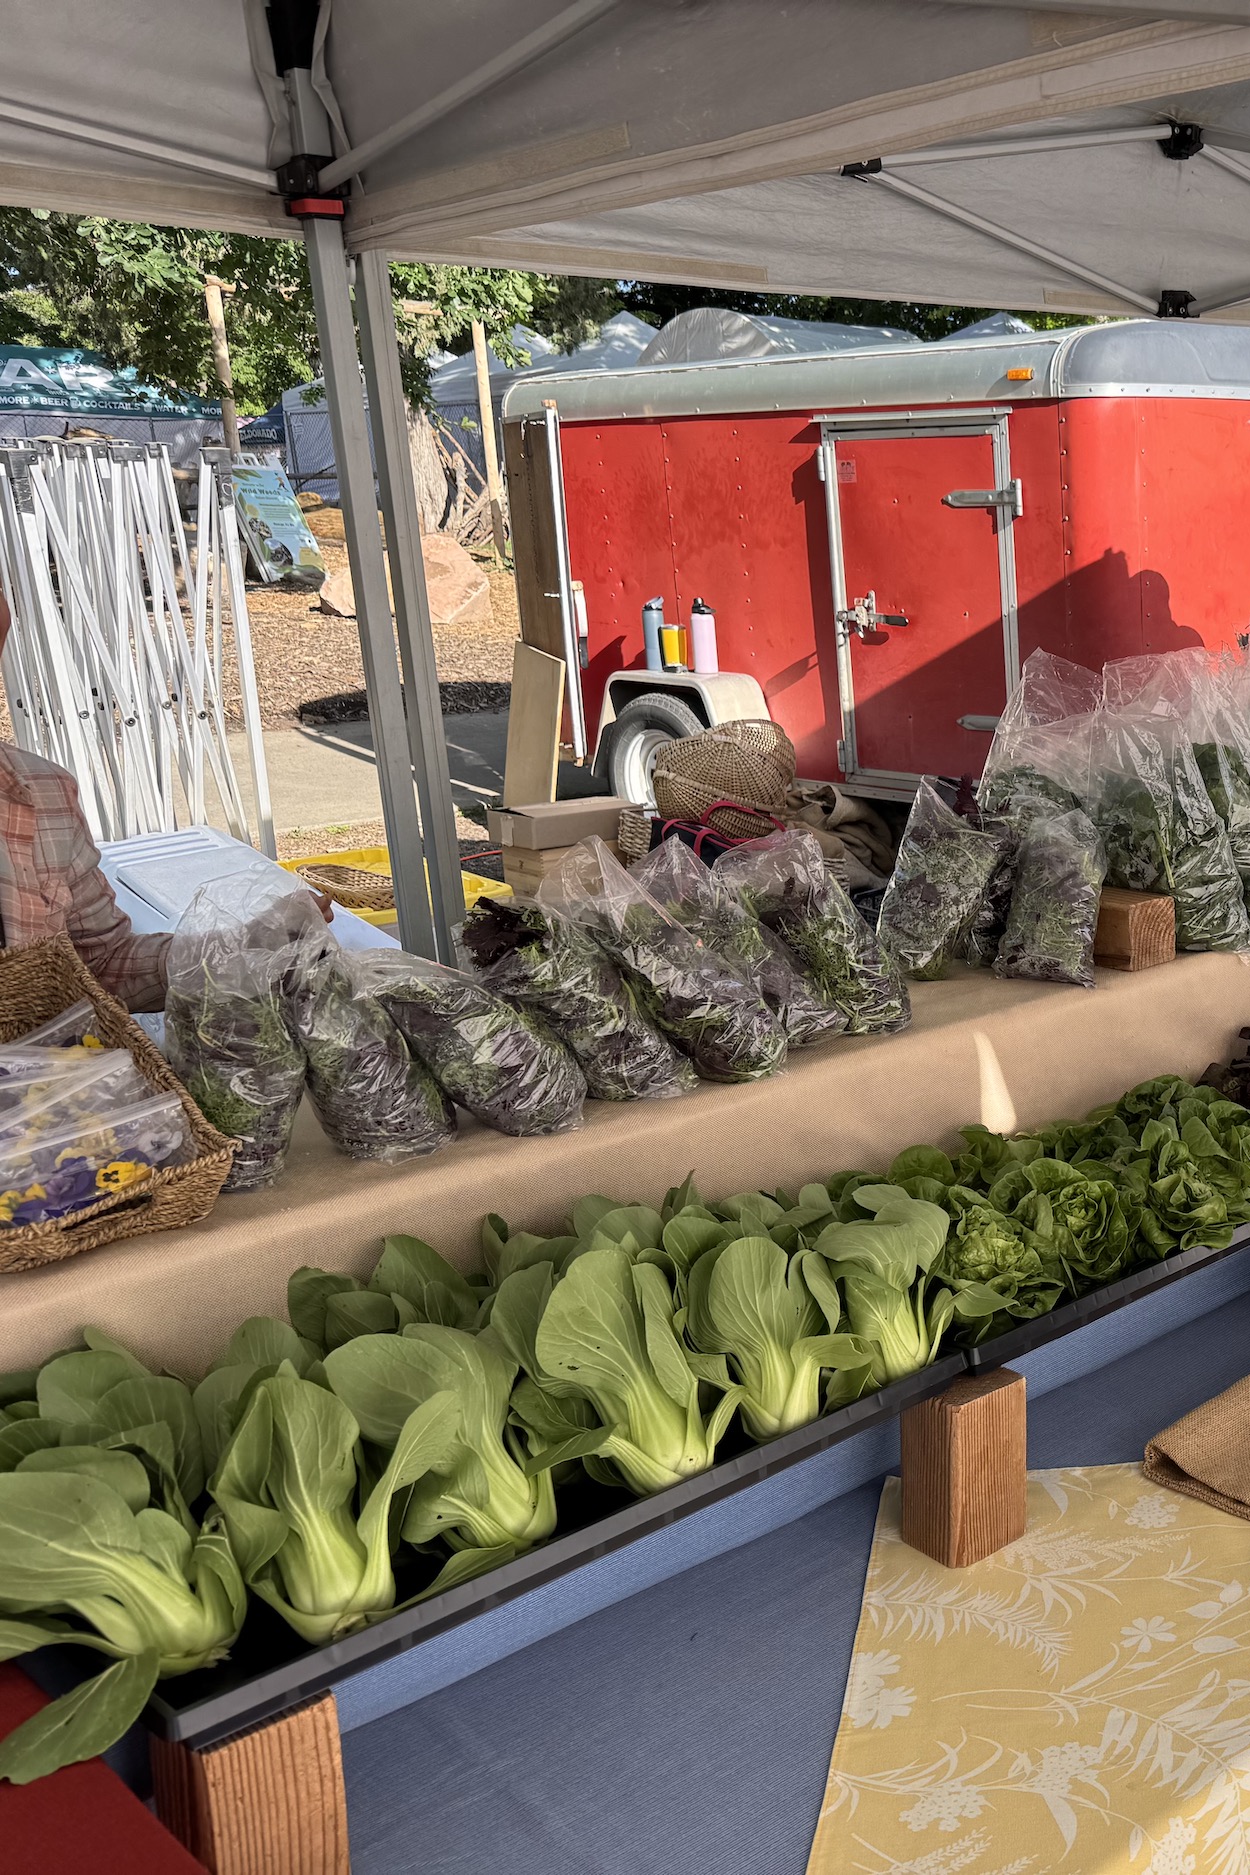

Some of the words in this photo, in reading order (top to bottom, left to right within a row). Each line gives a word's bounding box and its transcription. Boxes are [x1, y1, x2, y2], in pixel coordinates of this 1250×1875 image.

[40, 397, 69, 407] BEER
[83, 399, 141, 411] COCKTAILS
[154, 404, 188, 414] WATER
[201, 407, 222, 416] MOR
